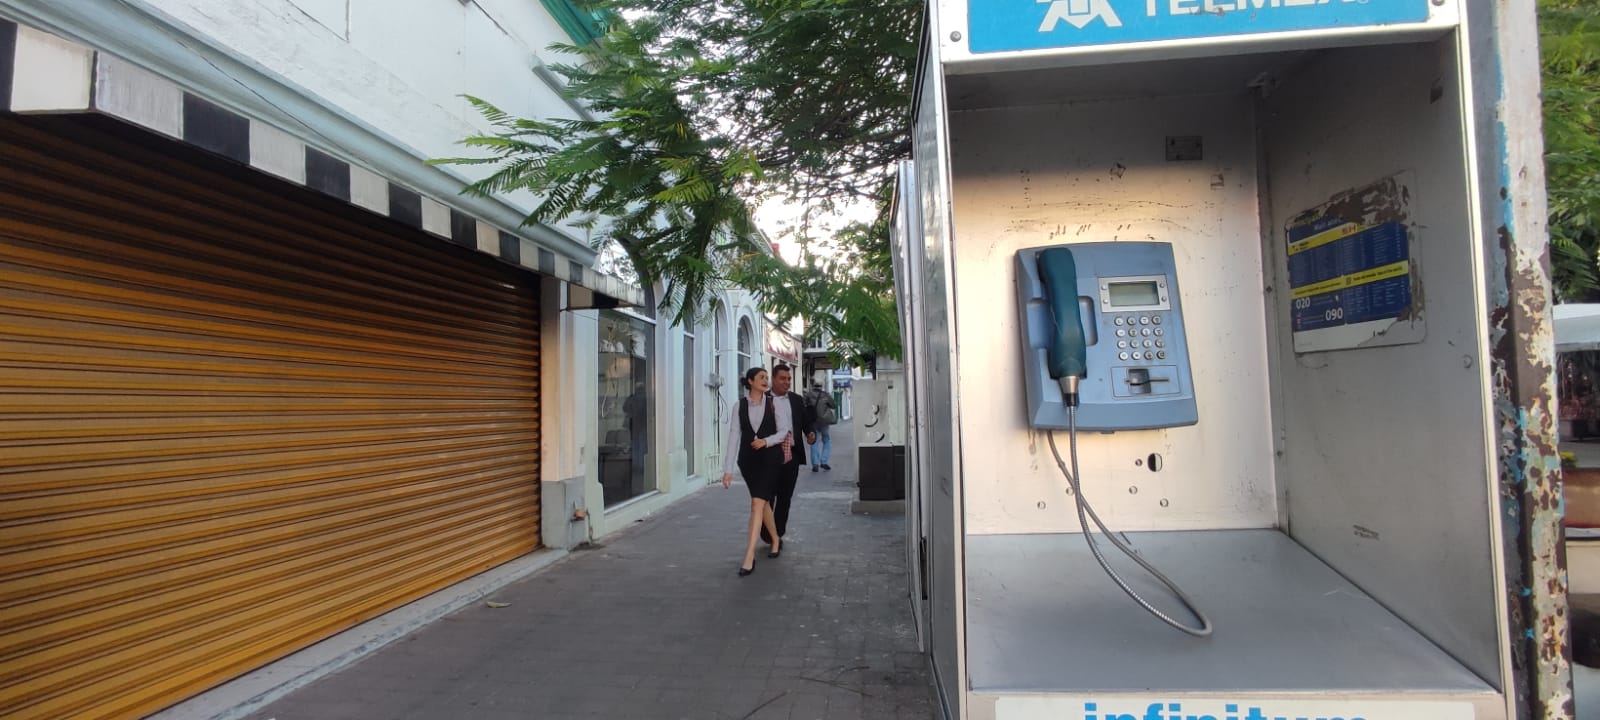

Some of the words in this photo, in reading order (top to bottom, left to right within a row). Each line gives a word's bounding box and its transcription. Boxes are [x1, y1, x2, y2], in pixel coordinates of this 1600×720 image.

[1147, 0, 1353, 16] TEL
[1296, 297, 1310, 309] 020
[1326, 307, 1343, 320] 090
[1085, 702, 1369, 720] ifiit
